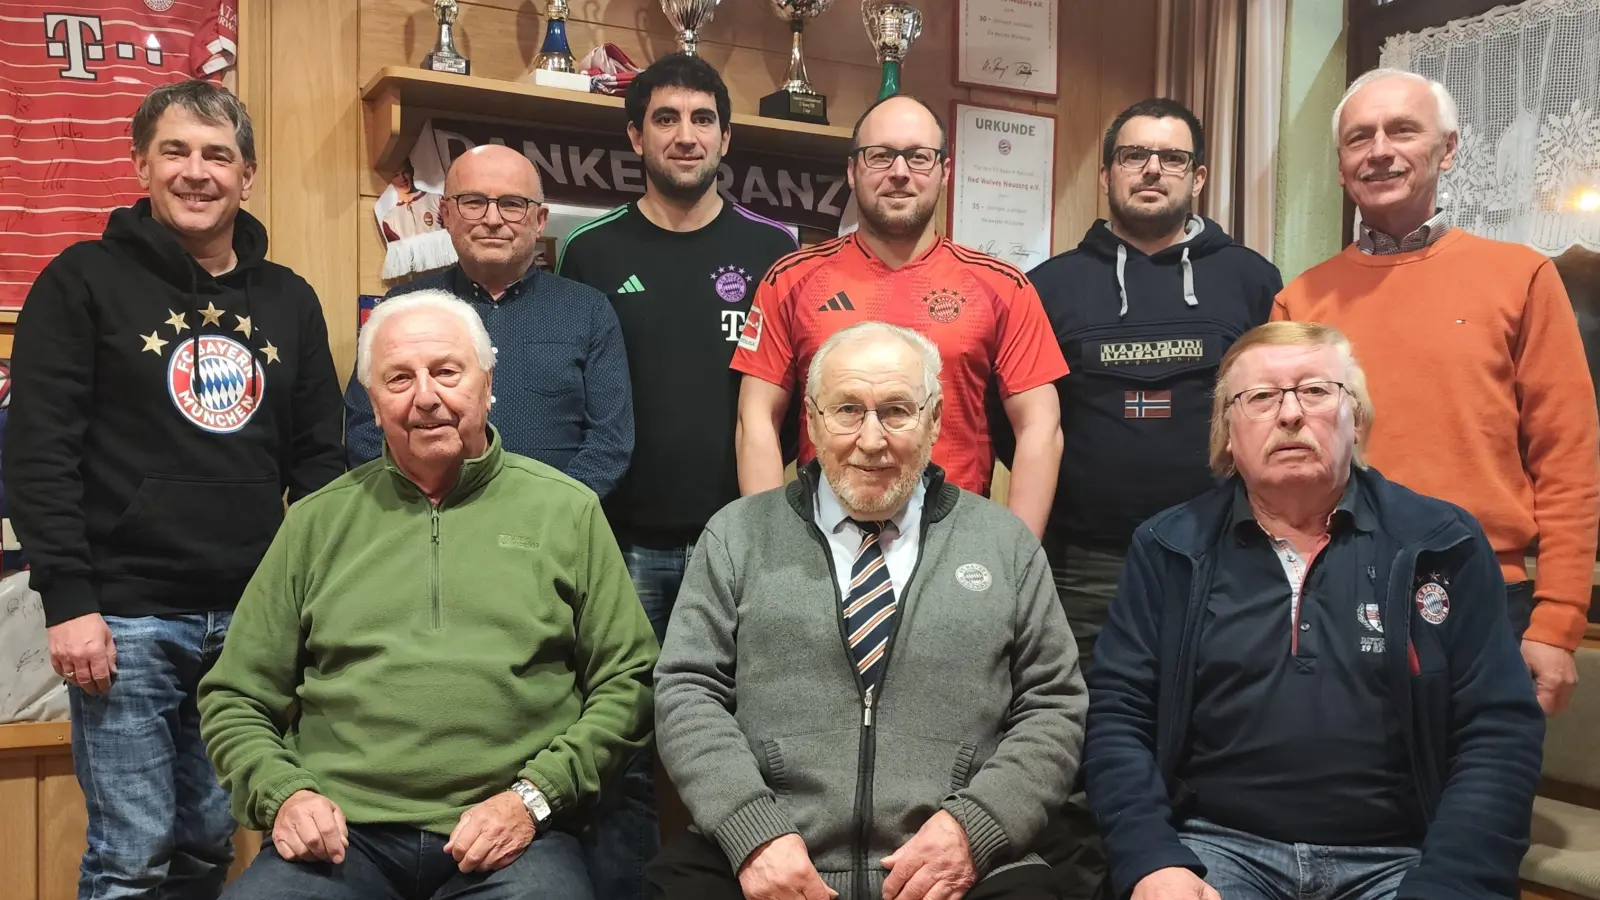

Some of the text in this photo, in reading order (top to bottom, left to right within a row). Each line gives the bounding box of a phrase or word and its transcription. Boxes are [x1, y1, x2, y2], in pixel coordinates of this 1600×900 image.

[975, 117, 1036, 137] URKUNDE
[434, 128, 846, 217] DNKE RANZ
[967, 175, 980, 184] Red
[981, 177, 1002, 187] Wolves
[721, 310, 745, 341] T
[1102, 340, 1202, 360] NAPAPIJRI
[176, 350, 194, 374] FC
